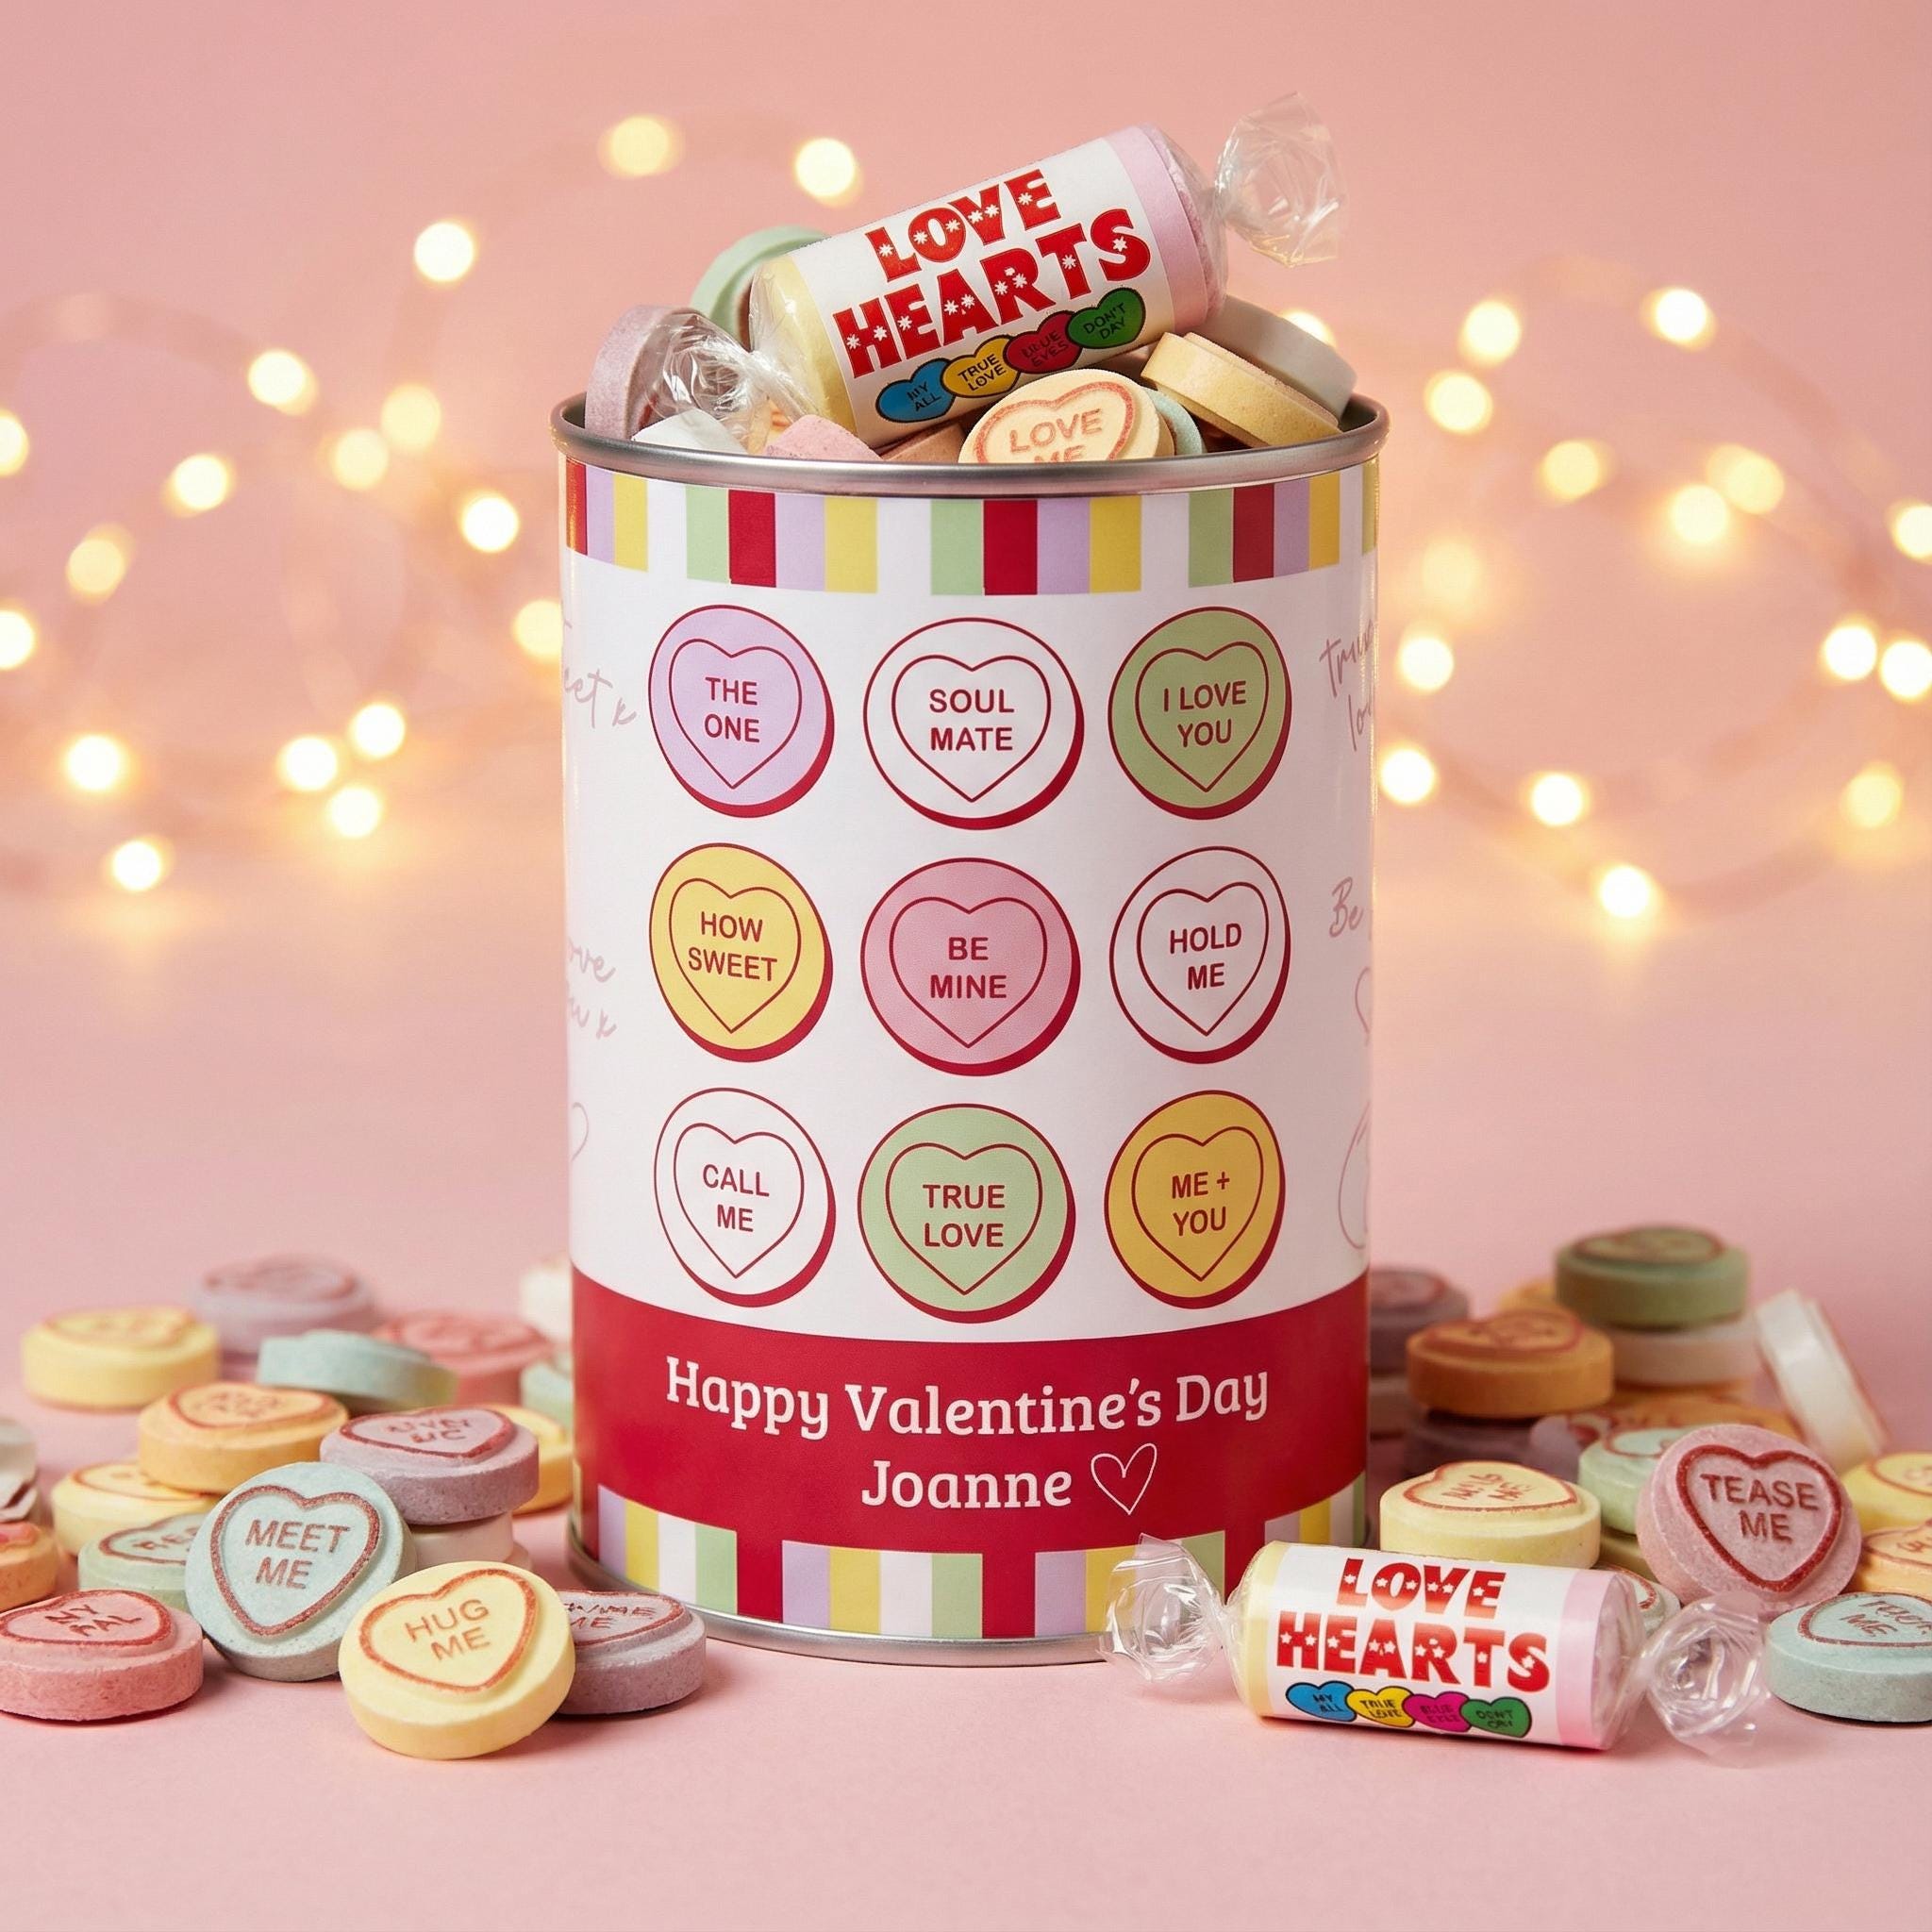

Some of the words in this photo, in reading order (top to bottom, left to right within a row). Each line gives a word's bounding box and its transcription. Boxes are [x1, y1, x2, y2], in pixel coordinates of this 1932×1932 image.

[865, 169, 1060, 282] LOVE
[833, 208, 1151, 378] HEARTS
[958, 354, 999, 382] TRUE
[968, 365, 1007, 391] LOVE
[914, 394, 942, 411] ALL
[1009, 408, 1104, 454] LOVE
[705, 676, 758, 705] THE
[929, 689, 1014, 713] SOUL
[1163, 688, 1170, 712] I
[1180, 680, 1246, 710] LOVE
[705, 713, 759, 742] ONE
[930, 727, 1013, 751] MATE
[1177, 718, 1232, 748] YOU
[701, 911, 763, 942] HOW
[1170, 923, 1241, 954] HOLD
[688, 947, 777, 981] SWEET
[948, 937, 989, 960] BE
[930, 974, 1008, 999] MINE
[1188, 962, 1224, 991] ME
[702, 1164, 770, 1197] CALL
[1172, 1171, 1208, 1199] ME
[923, 1184, 1006, 1209] TRUE
[717, 1205, 754, 1233] ME
[1173, 1207, 1226, 1237] YOU
[924, 1223, 1004, 1247] LOVE
[666, 1356, 828, 1441] Happy
[844, 1378, 1161, 1435] Valentine's
[1175, 1372, 1268, 1422] Day
[861, 1459, 1072, 1508] Joanne
[1700, 1473, 1819, 1510] TEASE
[244, 1519, 350, 1553] MEET
[1739, 1509, 1792, 1544] ME
[256, 1557, 313, 1590] ME
[1336, 1557, 1507, 1619] LOVE
[405, 1599, 490, 1642] HUG
[430, 1627, 491, 1660] ME
[1276, 1610, 1550, 1692] HEARTS
